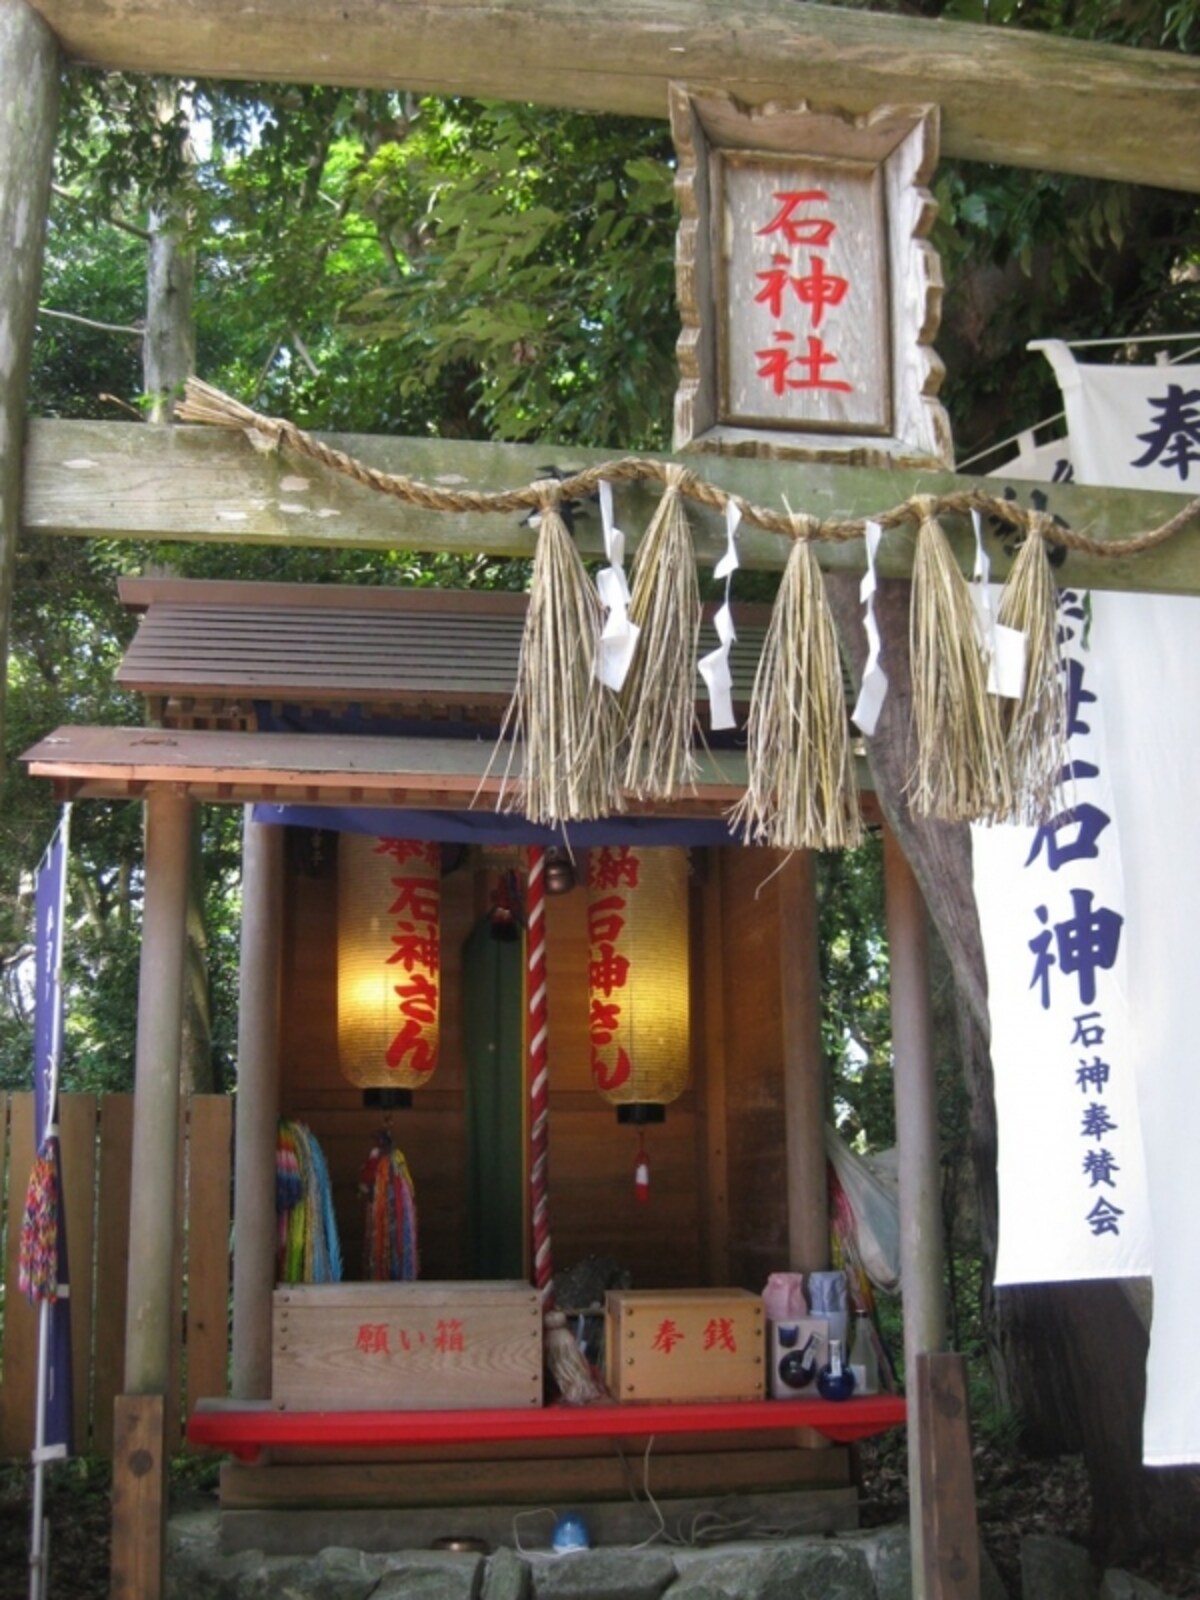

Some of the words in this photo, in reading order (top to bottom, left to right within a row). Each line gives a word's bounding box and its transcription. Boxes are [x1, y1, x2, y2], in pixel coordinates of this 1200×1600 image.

[754, 189, 854, 396] 石神社
[1069, 1011, 1126, 1237] 石神奉賛会
[355, 1319, 467, 1354] 願い箱
